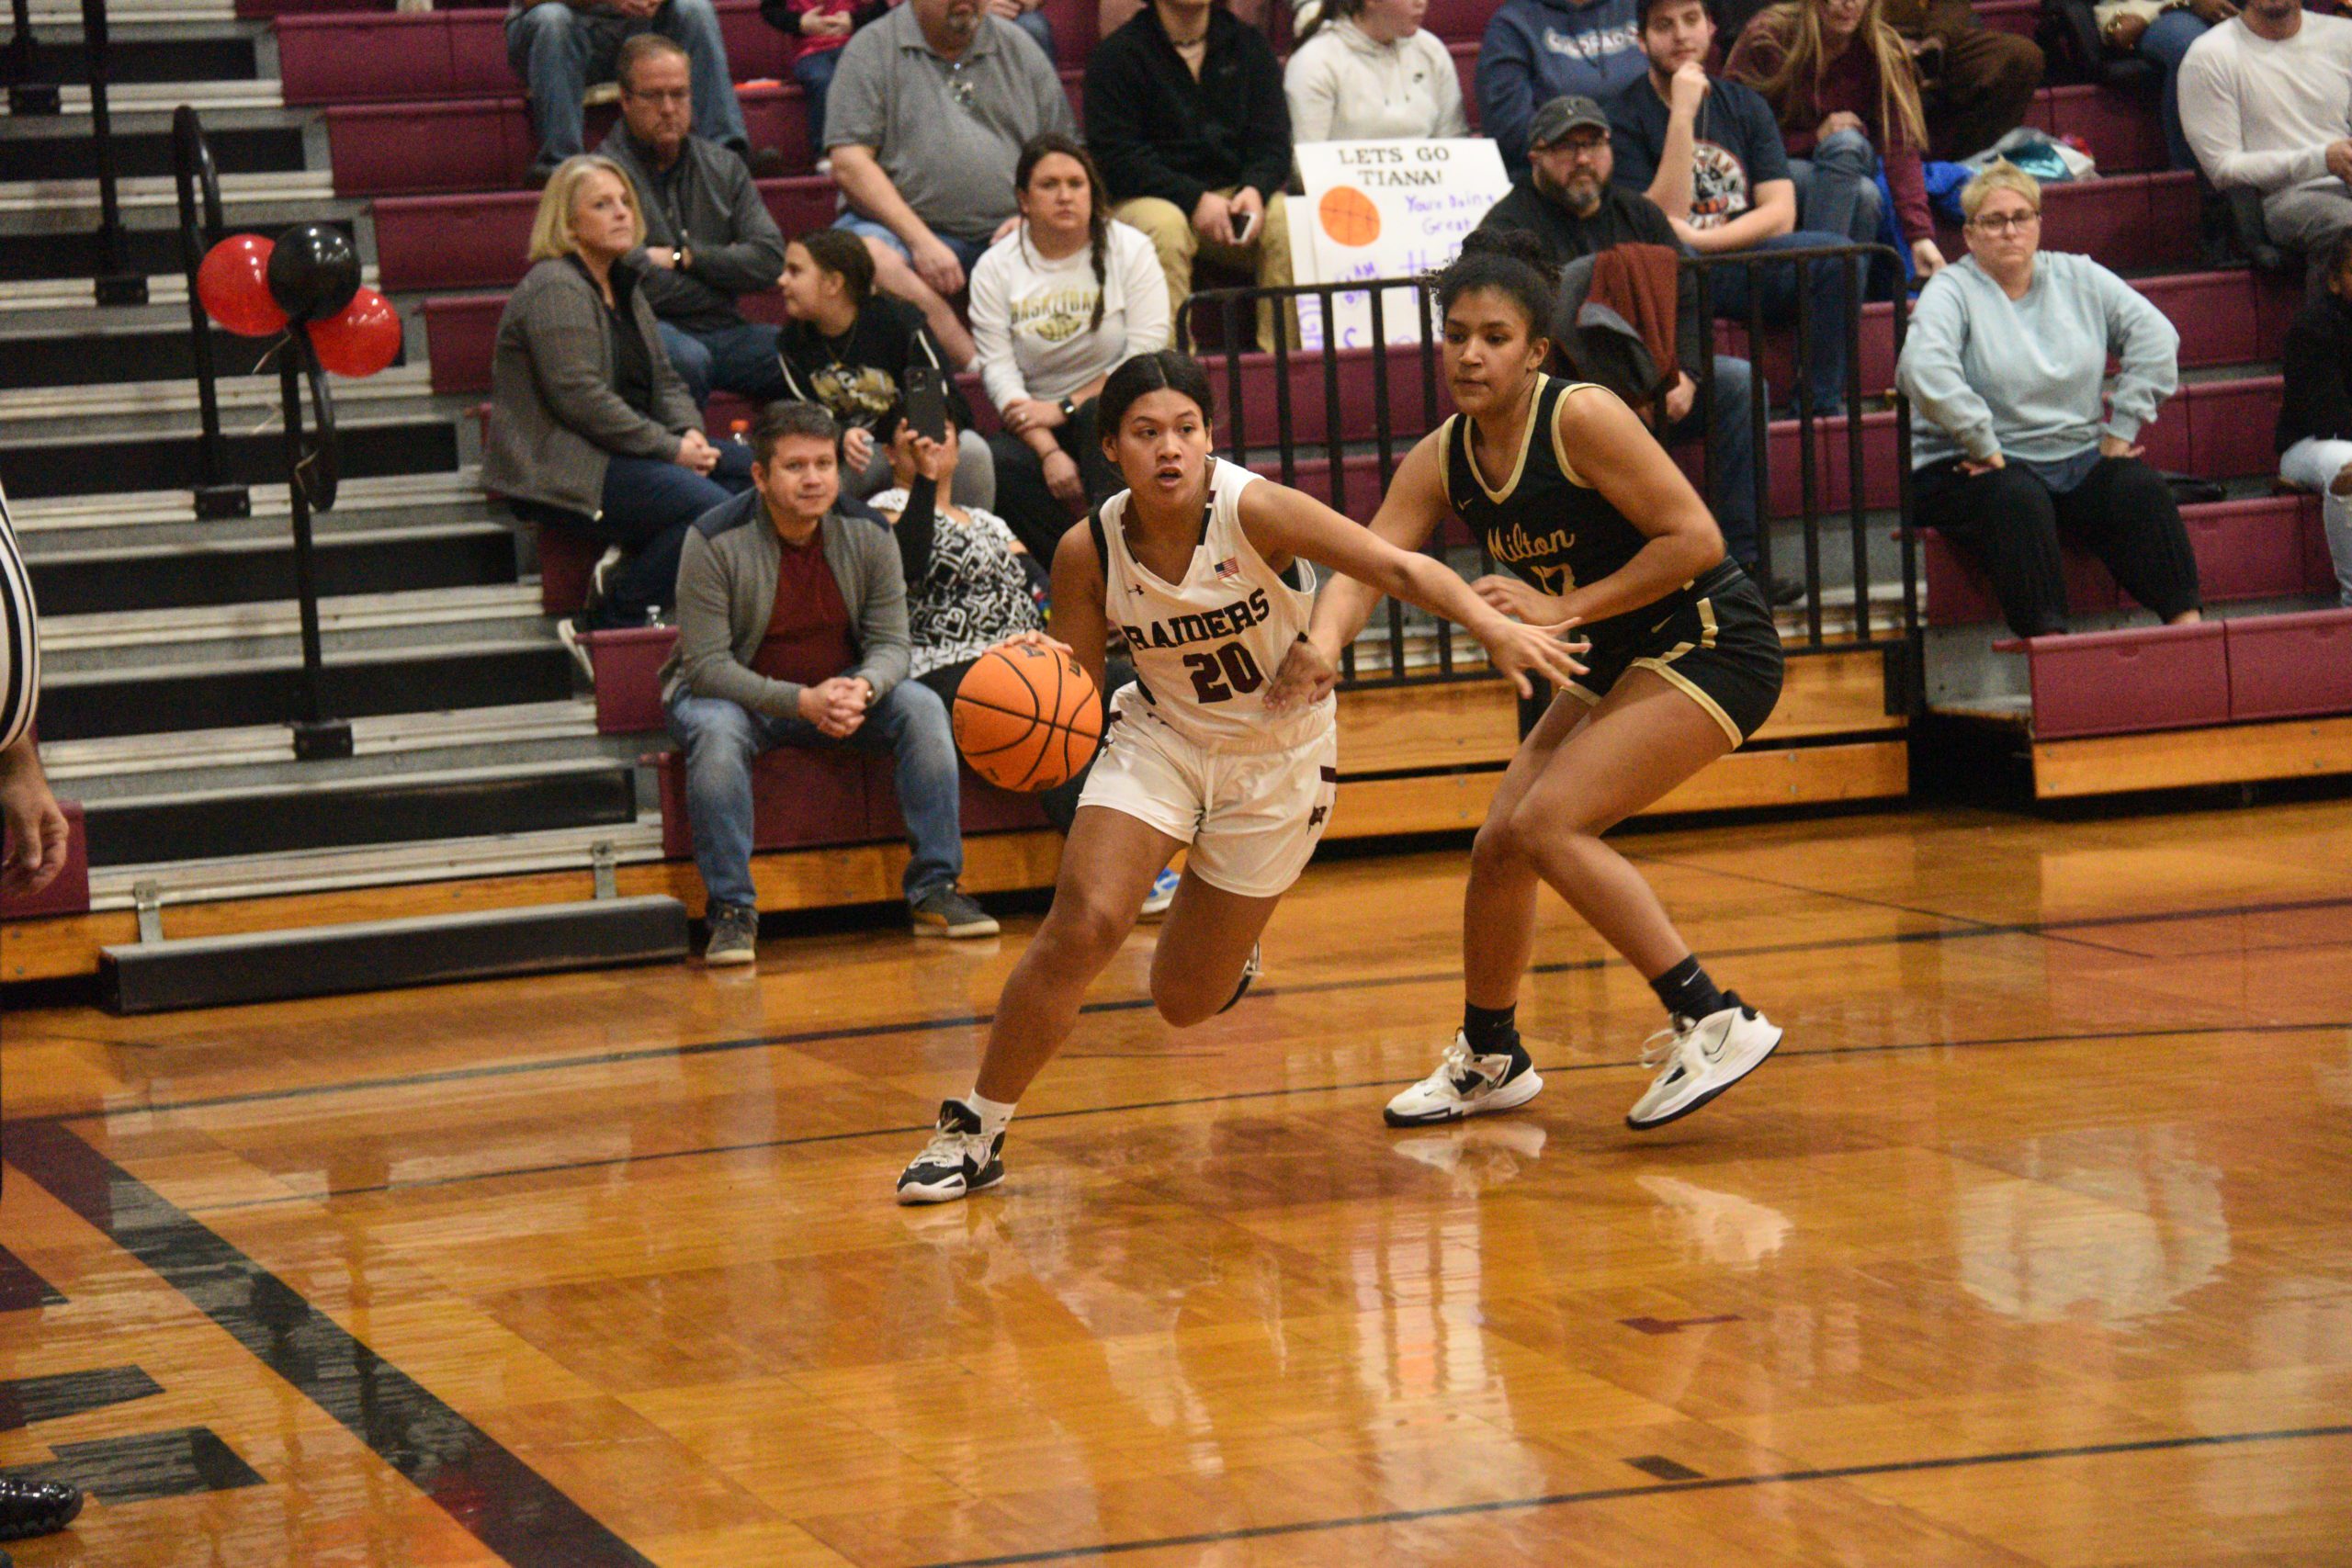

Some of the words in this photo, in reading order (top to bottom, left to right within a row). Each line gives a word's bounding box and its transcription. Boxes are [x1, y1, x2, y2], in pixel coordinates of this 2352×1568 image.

[1339, 147, 1404, 165] LETS
[1417, 146, 1451, 163] GO
[1357, 170, 1442, 186] TIANA!
[1487, 522, 1576, 563] Milton
[1122, 588, 1270, 651] RAIDERS
[1182, 641, 1263, 704] 20
